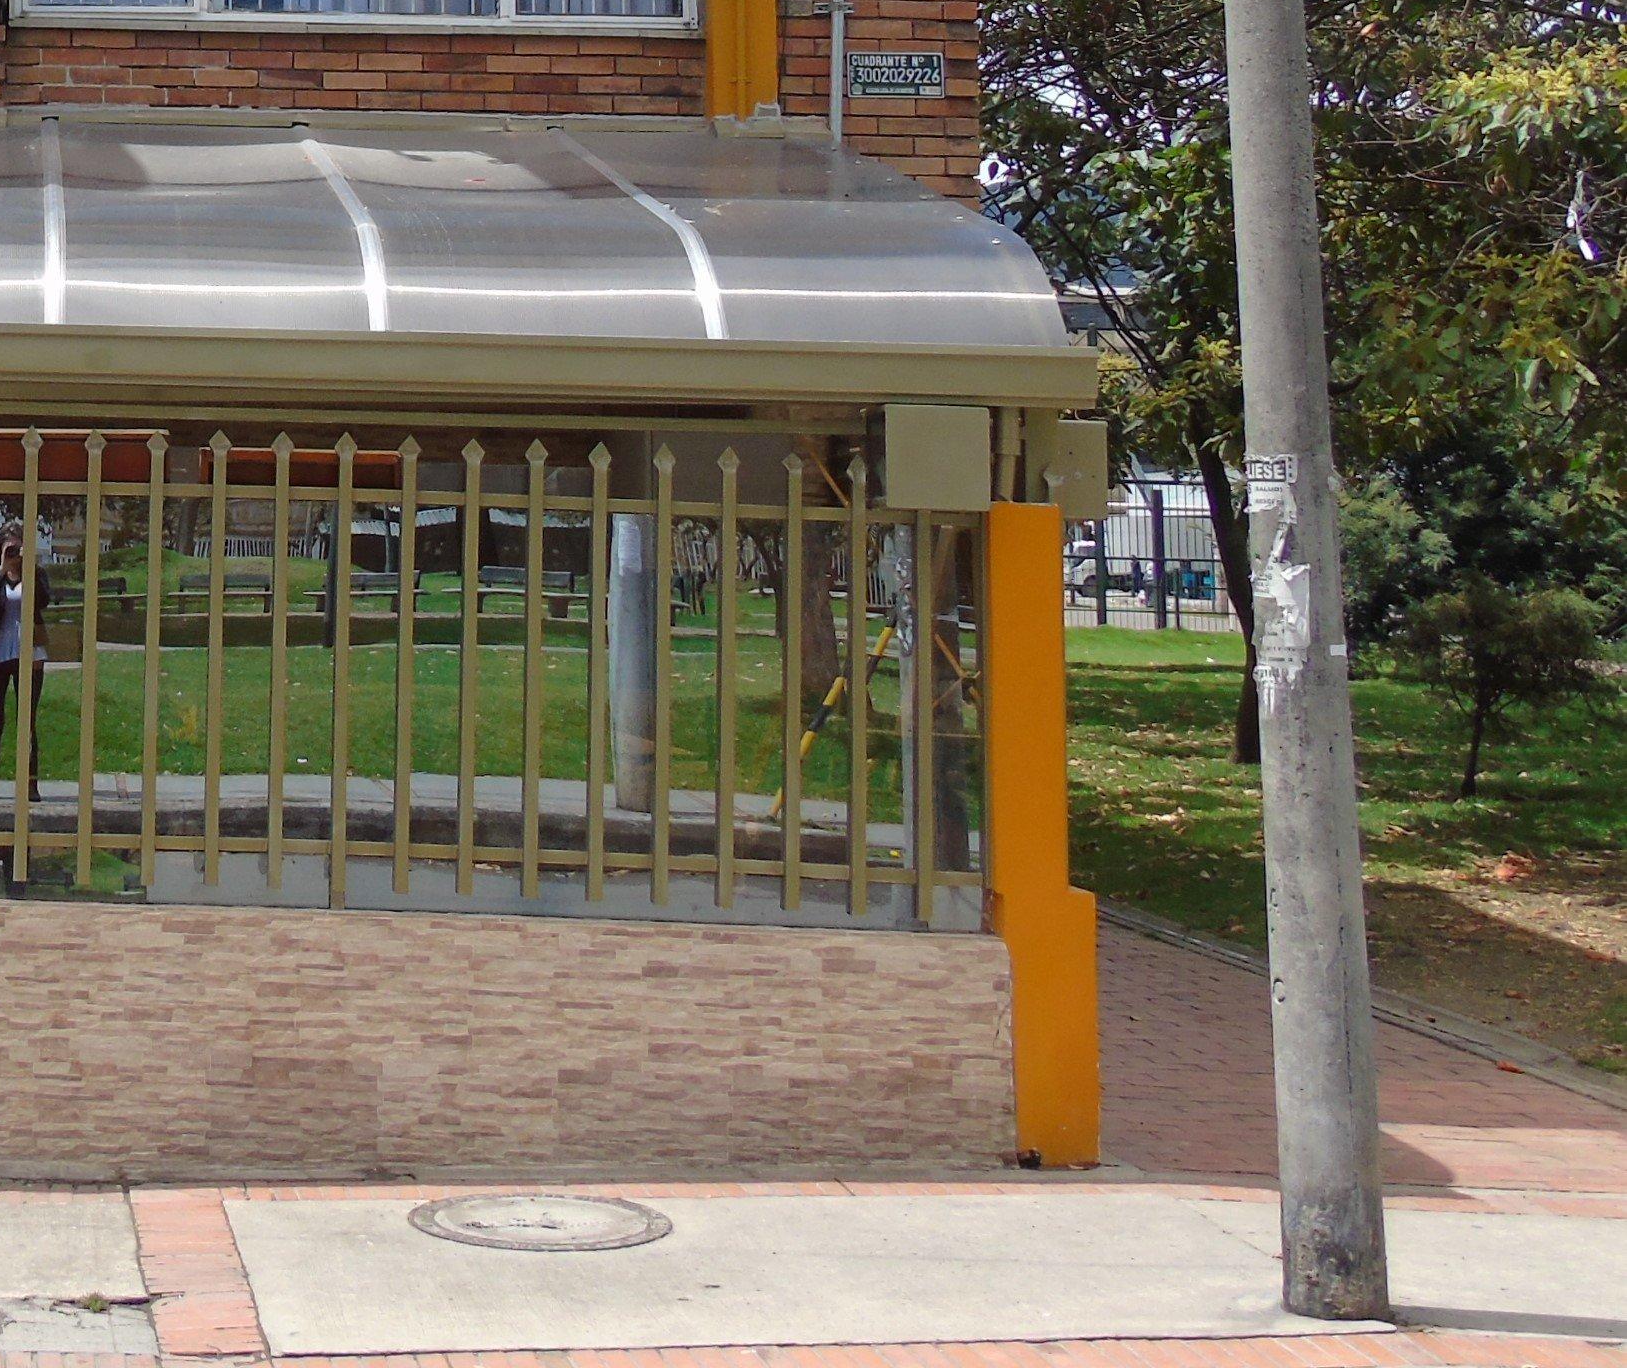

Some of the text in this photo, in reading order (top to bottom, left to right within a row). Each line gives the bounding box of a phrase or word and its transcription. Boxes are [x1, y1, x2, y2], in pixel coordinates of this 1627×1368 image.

[851, 55, 907, 67] CUADRANTE
[932, 56, 938, 68] 1
[856, 67, 941, 84] 3002029226
